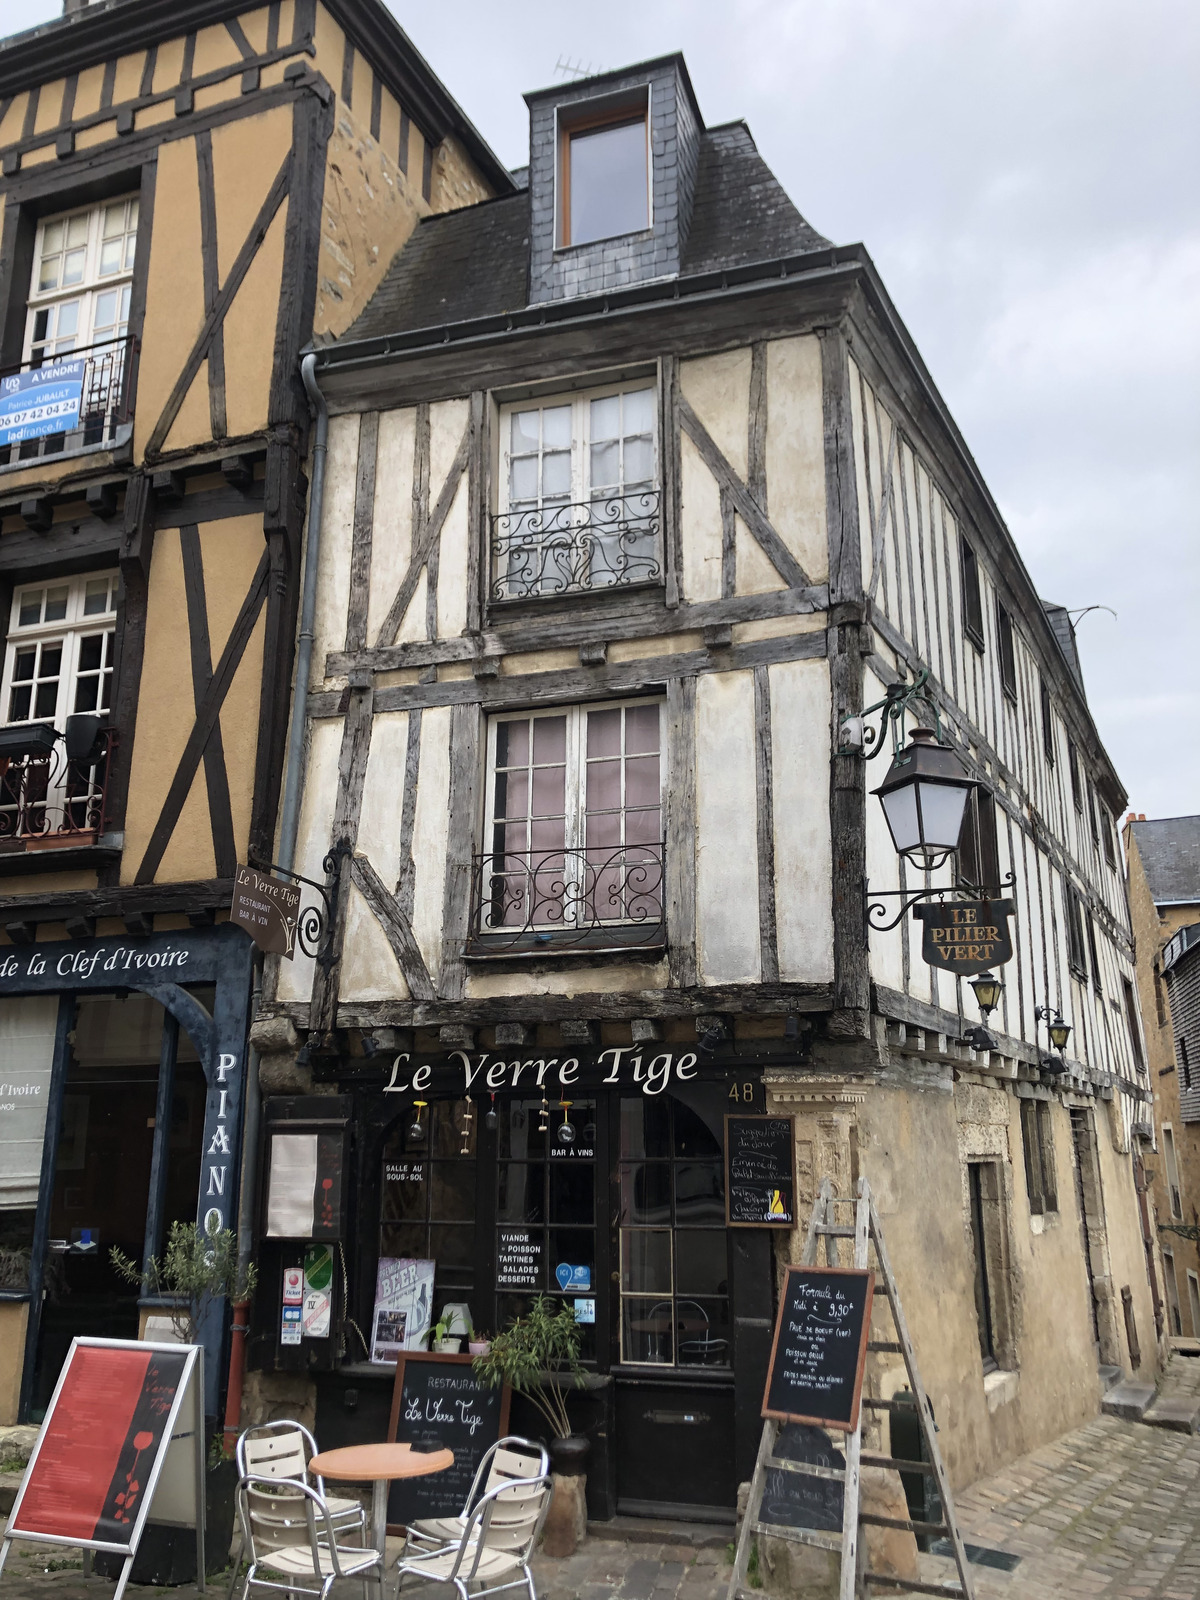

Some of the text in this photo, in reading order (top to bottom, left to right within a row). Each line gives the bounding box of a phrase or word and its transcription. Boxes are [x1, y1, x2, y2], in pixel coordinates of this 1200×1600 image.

[31, 363, 79, 383] A VENDRE
[35, 390, 70, 403] JUBAULT
[0, 401, 76, 427] 06 07 42 04 24
[237, 869, 300, 907] Le Verre Tige
[239, 895, 271, 914] RESTAURANT
[239, 909, 250, 920] BAR
[258, 916, 269, 926] VIN
[951, 908, 977, 924] LE
[931, 926, 1003, 943] PILIER
[937, 944, 995, 961] VERT
[0, 946, 190, 979] de la Clef d'Ivoire
[382, 1043, 698, 1095] Le Verre Tige
[728, 1082, 754, 1102] 48
[0, 1102, 16, 1111] NOS
[551, 1147, 594, 1157] BAR À VINS
[385, 1164, 423, 1172] SALLE AU
[501, 1234, 529, 1242] VIANDE
[507, 1245, 541, 1254] POISSON
[498, 1255, 534, 1263] TARTINES
[503, 1265, 539, 1274] SALADES
[381, 1264, 419, 1298] BEER
[498, 1275, 535, 1284] DESSERTS
[799, 1283, 846, 1300] Formule du
[307, 1301, 316, 1310] IV
[794, 1299, 807, 1311] Midi
[427, 1376, 487, 1391] RESTAURANT
[404, 1398, 423, 1421] Le
[425, 1397, 454, 1422] Verre
[455, 1400, 484, 1437] Tige
